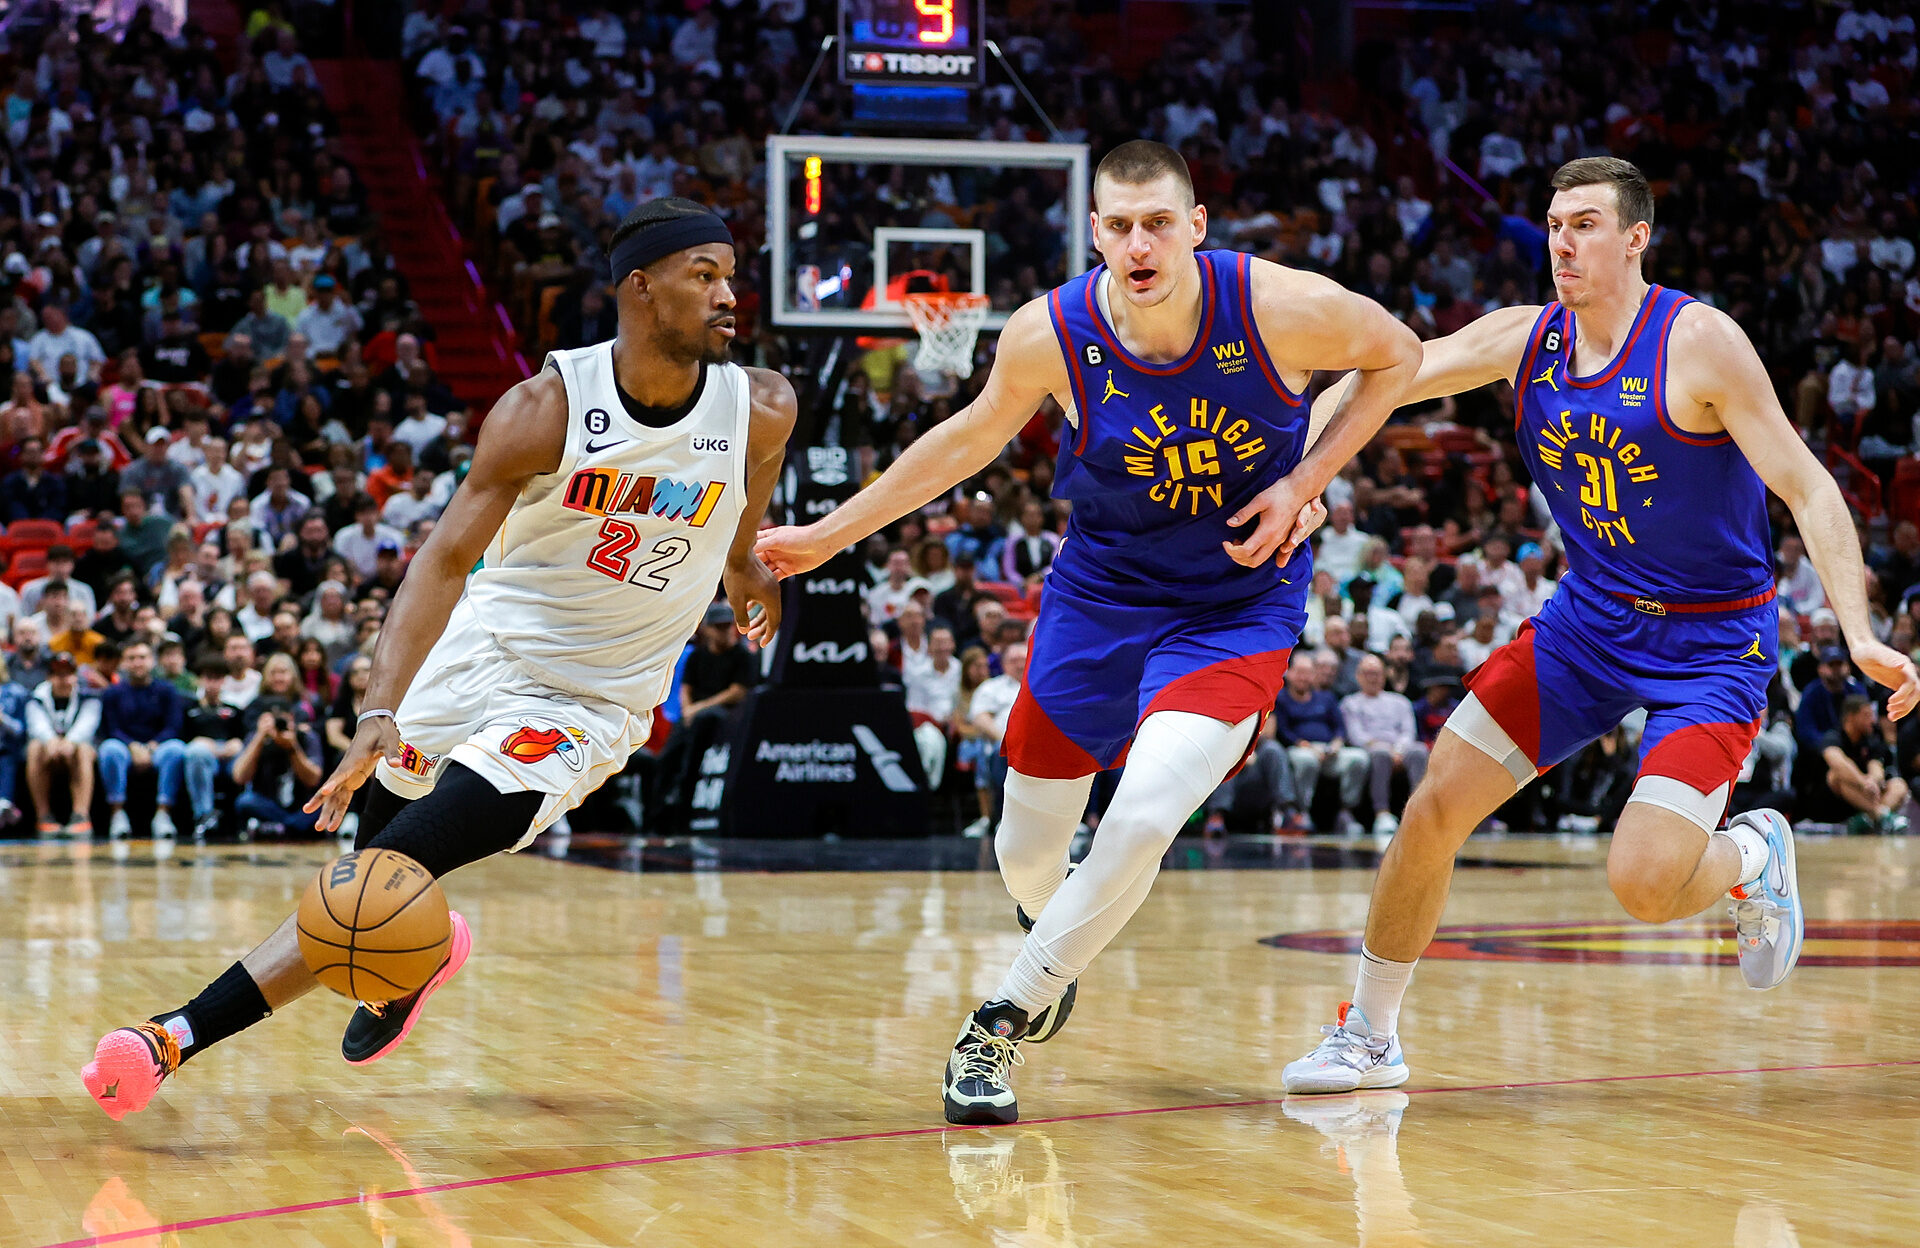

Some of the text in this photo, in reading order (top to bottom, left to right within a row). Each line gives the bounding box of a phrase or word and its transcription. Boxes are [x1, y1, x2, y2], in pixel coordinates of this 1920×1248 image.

[1212, 340, 1246, 361] WU
[1545, 332, 1560, 351] 6
[1086, 345, 1103, 365] 6
[1216, 357, 1248, 369] Western
[1222, 365, 1245, 375] Union
[1621, 376, 1648, 393] WU
[1619, 393, 1646, 401] Western
[1622, 399, 1642, 407] Union
[590, 411, 605, 432] 6
[1124, 397, 1267, 477] MILE HIGH
[1538, 410, 1660, 484] MILE HIGH
[1163, 438, 1221, 482] 15
[1574, 451, 1619, 513] 31
[562, 467, 727, 528] MIAMI
[1149, 479, 1223, 516] CITY
[1581, 506, 1636, 547] CITY
[586, 517, 691, 592] 22
[755, 738, 857, 762] American
[775, 760, 857, 783] Airlines
